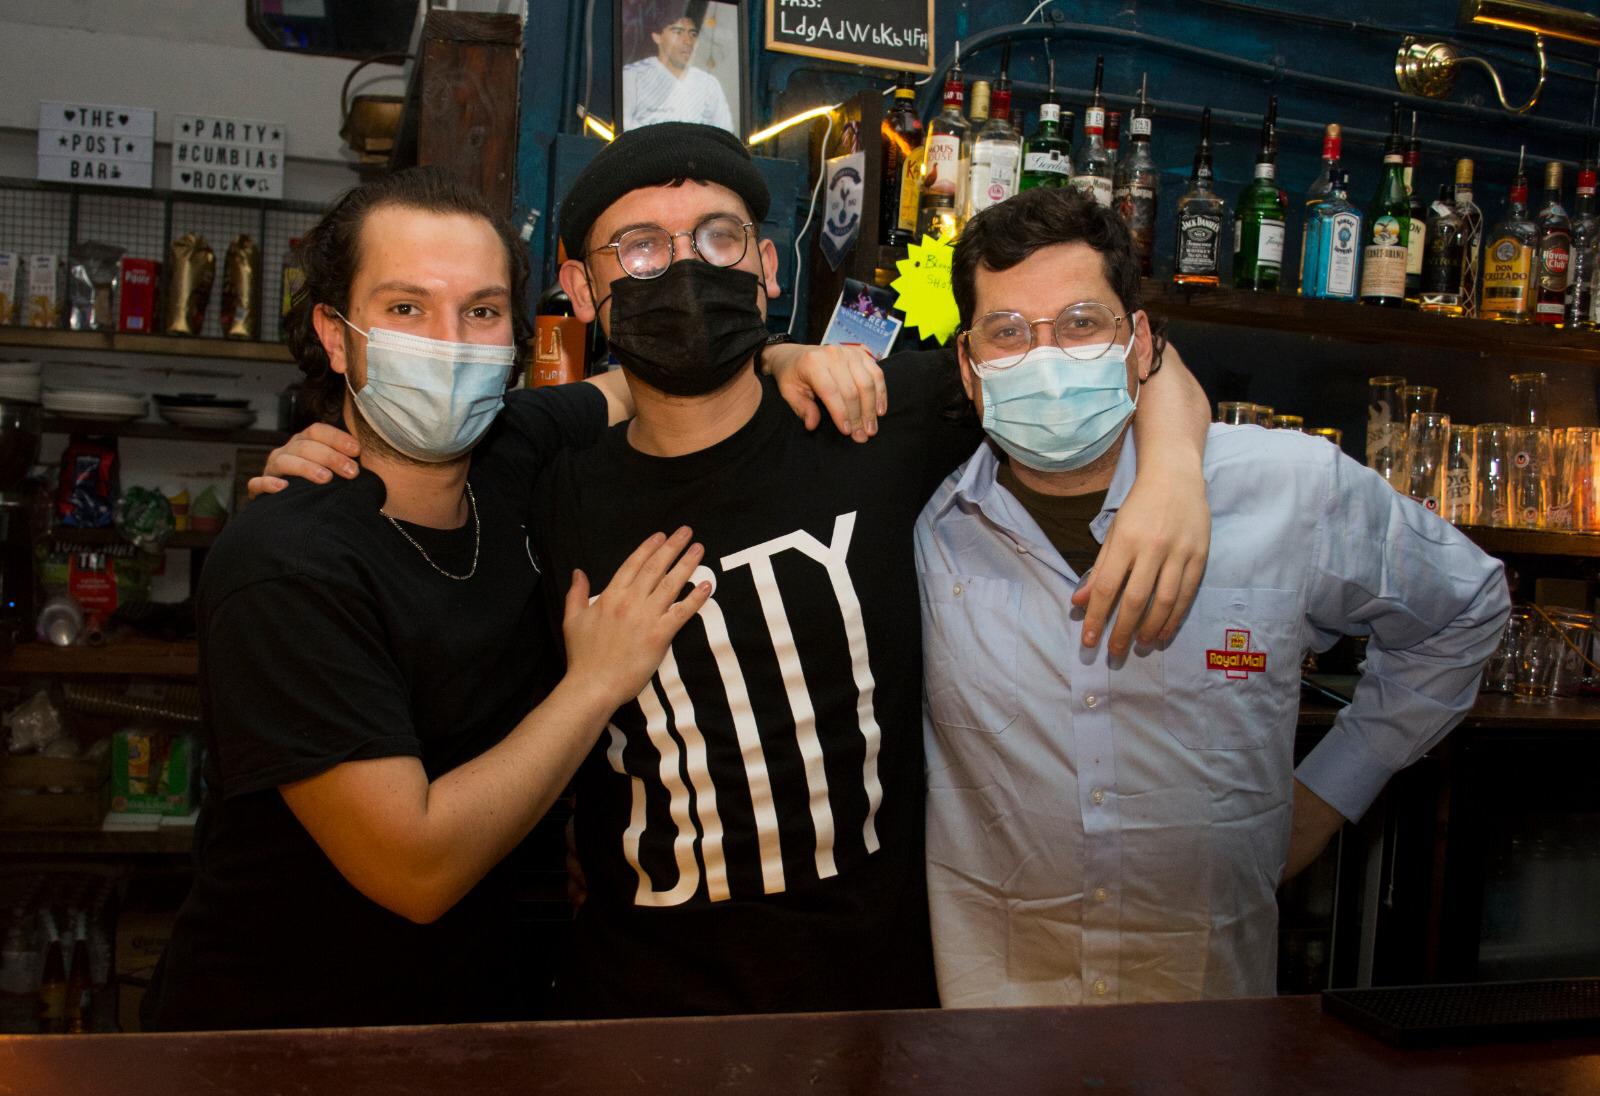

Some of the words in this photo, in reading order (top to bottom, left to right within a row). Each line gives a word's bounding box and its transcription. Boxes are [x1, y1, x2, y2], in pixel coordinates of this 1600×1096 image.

[78, 108, 115, 129] THE
[194, 119, 267, 143] PARTY
[71, 133, 123, 155] POST
[70, 160, 107, 180] BAR
[193, 171, 242, 192] ROCK
[1495, 264, 1513, 272] DON
[1549, 259, 1566, 270] Club
[1209, 652, 1240, 668] Royal
[1241, 654, 1265, 668] Mail
